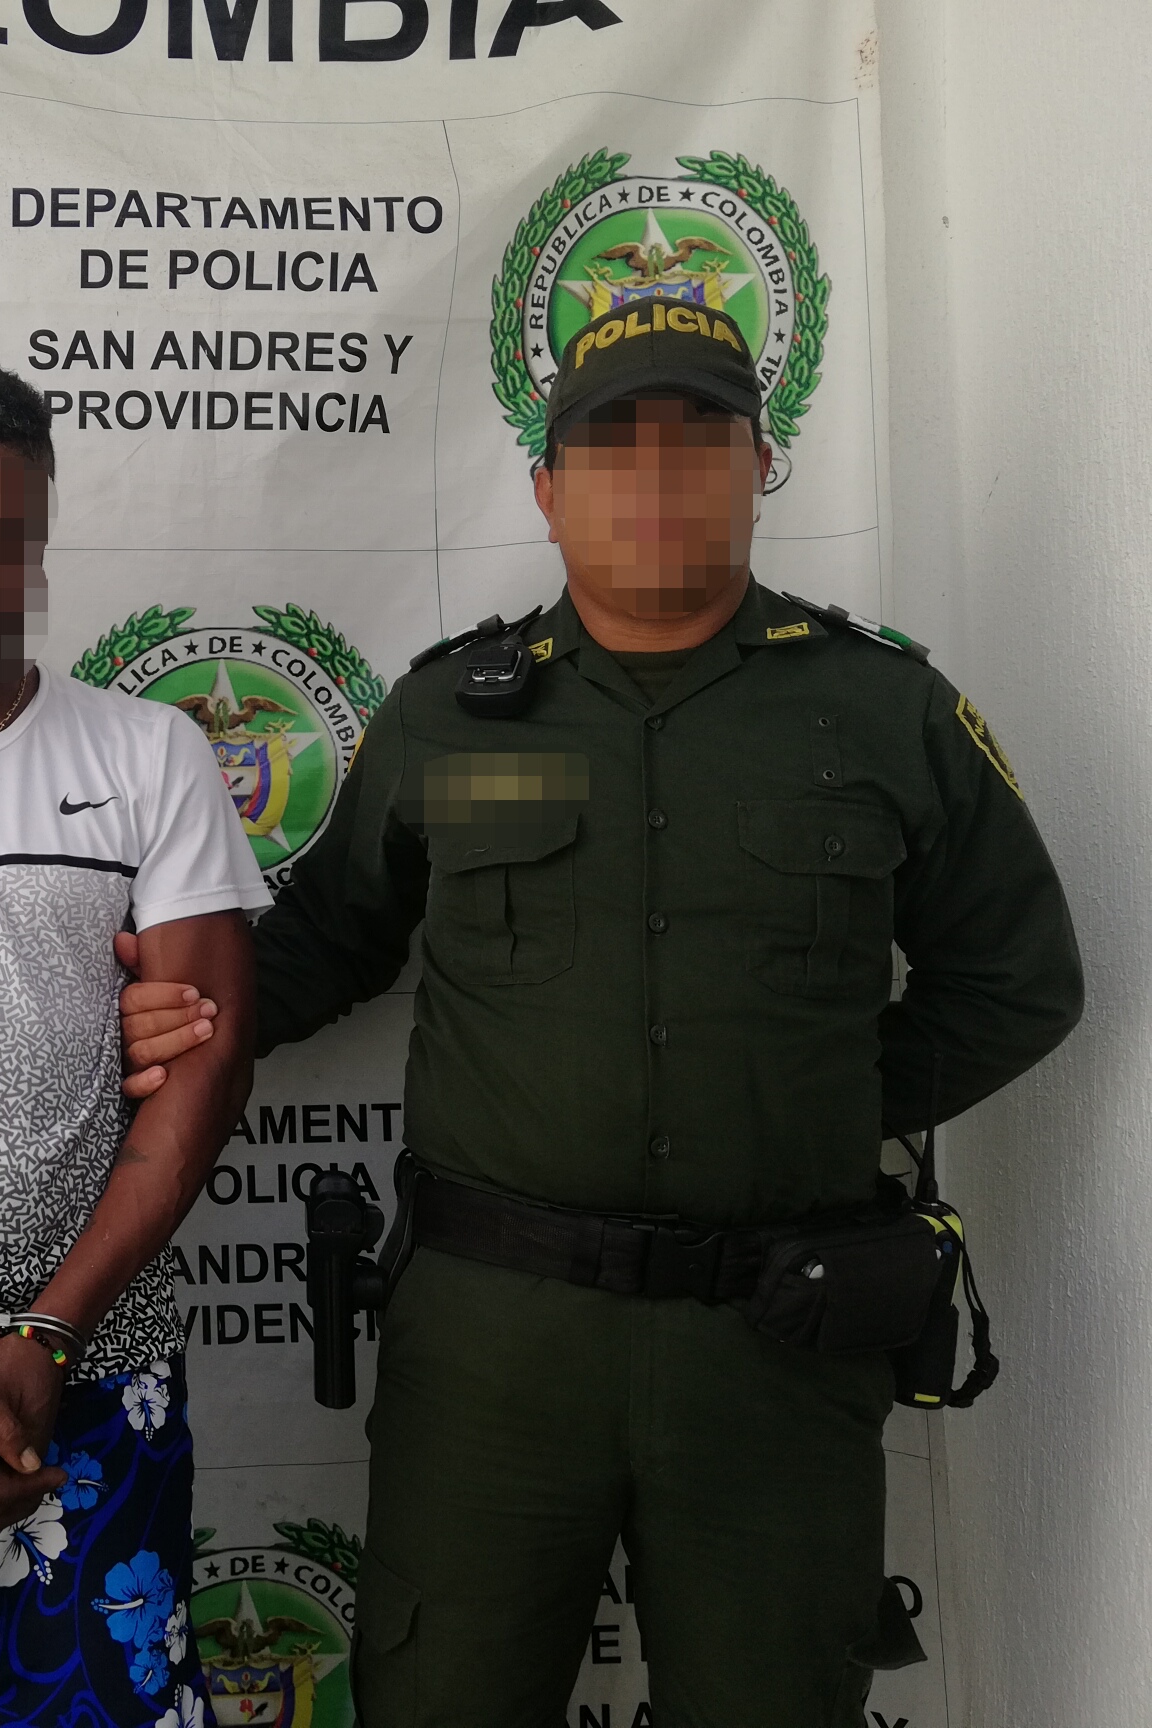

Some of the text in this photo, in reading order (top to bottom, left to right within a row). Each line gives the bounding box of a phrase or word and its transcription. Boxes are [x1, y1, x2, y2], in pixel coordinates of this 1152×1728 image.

[11, 187, 443, 234] DEPARTAMENTO
[80, 249, 378, 292] DE POLICIA
[529, 185, 789, 330] REPUBLICA DE COLOMBIA
[28, 329, 414, 374] SAN ANDRES Y
[575, 304, 742, 369] POLICIA
[43, 390, 391, 434] PROVIDENCIA
[208, 635, 243, 655] DE
[230, 1555, 266, 1576] DE
